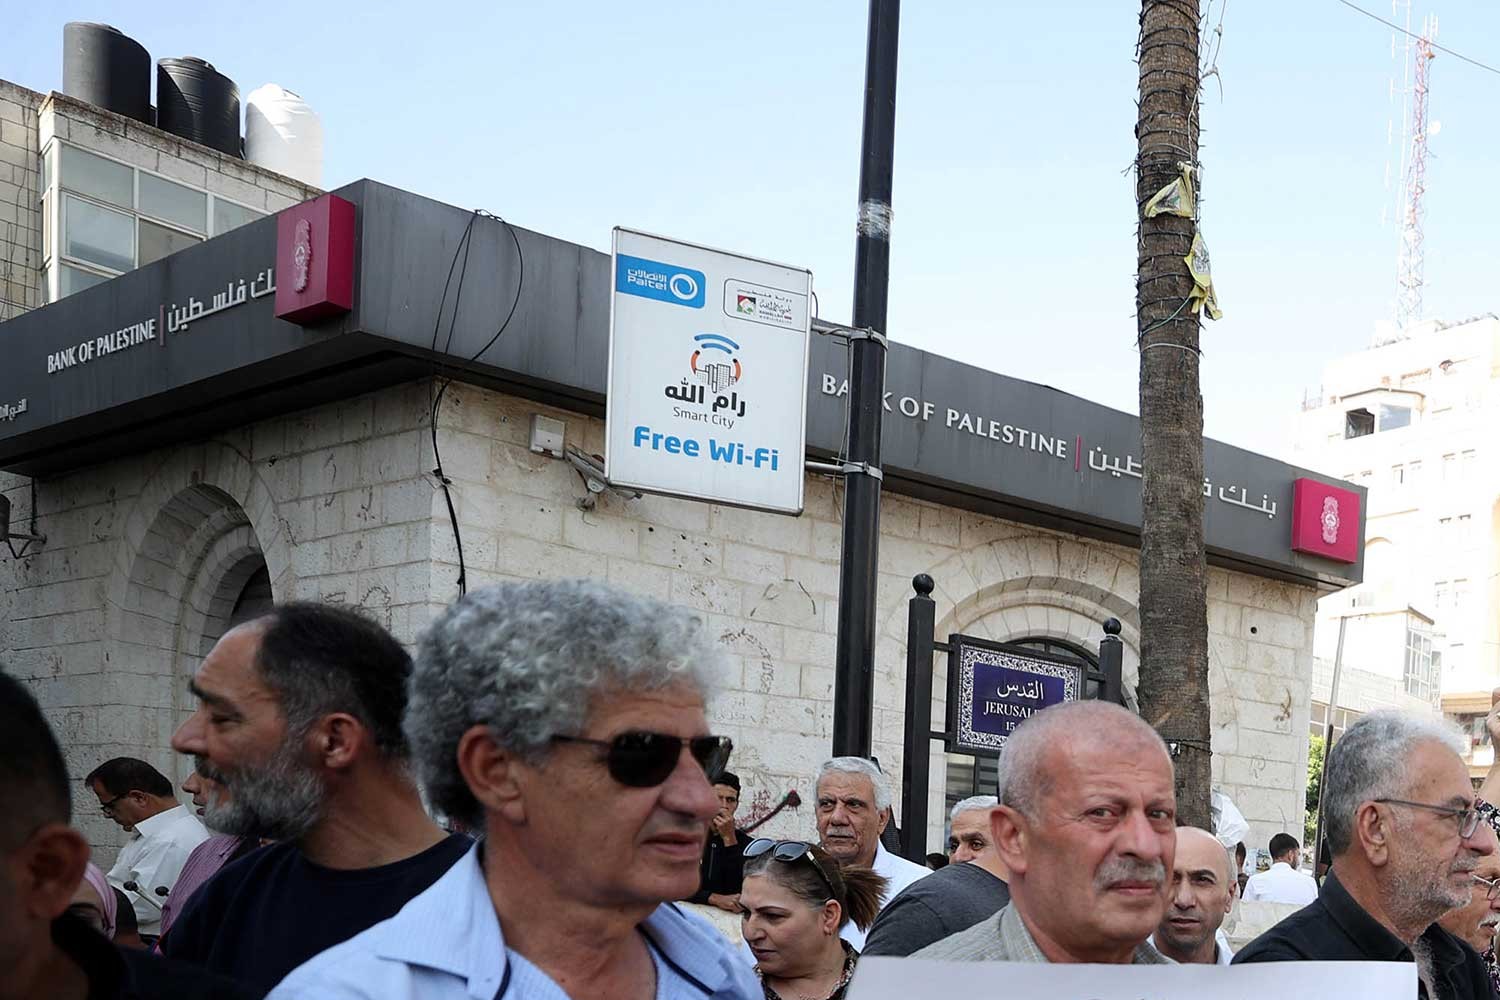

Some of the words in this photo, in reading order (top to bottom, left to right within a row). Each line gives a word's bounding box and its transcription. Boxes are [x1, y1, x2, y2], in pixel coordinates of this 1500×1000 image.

[627, 275, 667, 291] Paltel
[168, 278, 247, 333] فلسطين
[47, 346, 77, 374] BANK
[79, 339, 95, 363] OF
[96, 318, 157, 357] PALESTINE
[664, 377, 705, 404] الله
[712, 391, 746, 417] رام
[673, 406, 708, 423] Smart
[712, 414, 735, 430] City
[821, 373, 894, 412] BAK
[900, 396, 935, 421] OF
[946, 408, 1068, 459] PALESTINE
[634, 425, 700, 457] Free
[709, 439, 779, 471] Wi-Fi
[1218, 484, 1277, 519] بنك
[996, 680, 1044, 700] القدس
[983, 701, 1041, 719] JERUSAL
